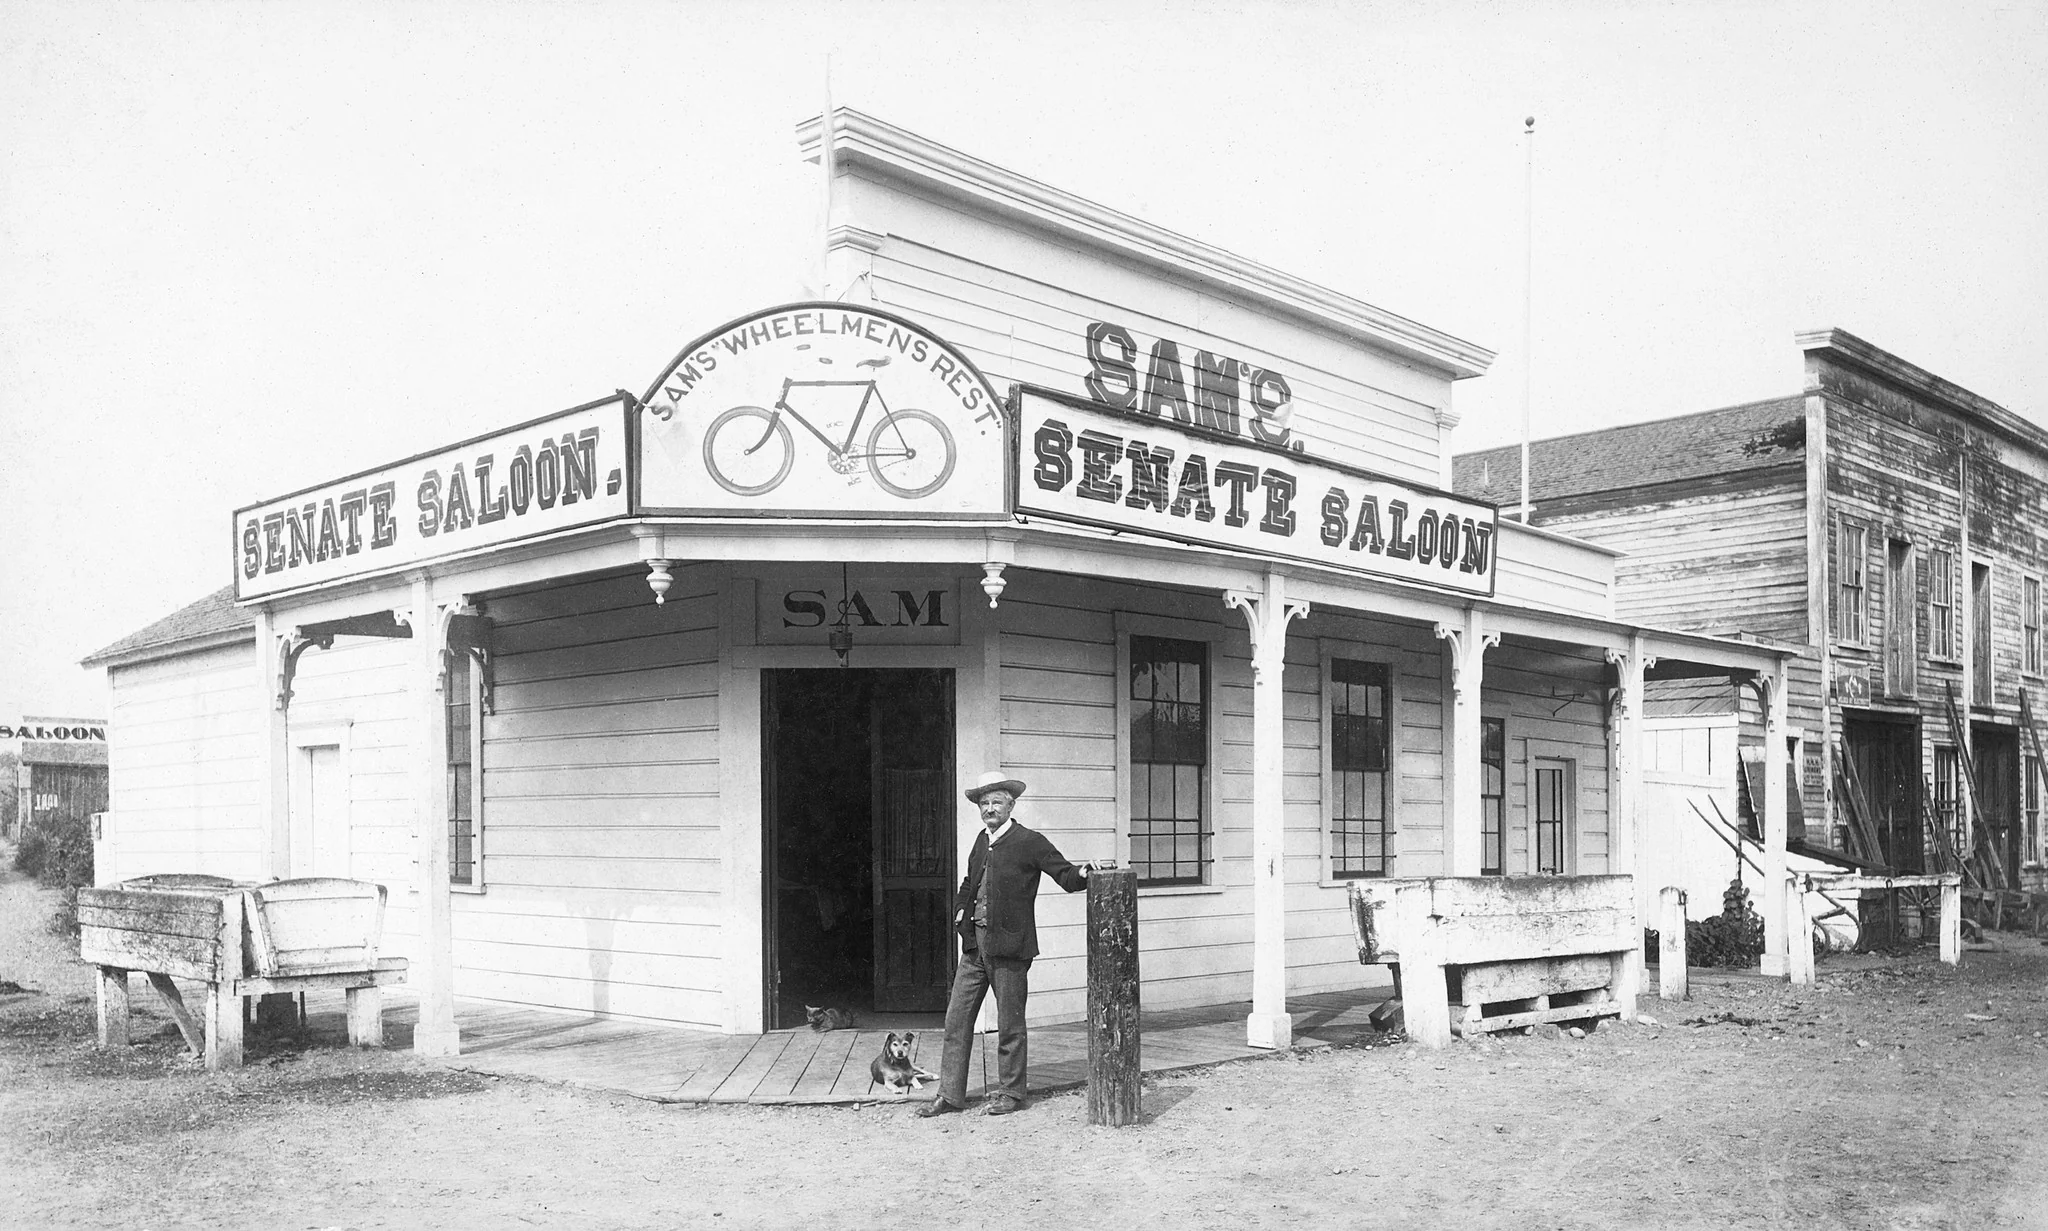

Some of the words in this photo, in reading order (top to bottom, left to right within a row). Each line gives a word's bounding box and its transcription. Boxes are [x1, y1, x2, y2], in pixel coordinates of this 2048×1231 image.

[650, 350, 717, 422] SAM'S
[242, 480, 398, 580] SENATE
[416, 426, 622, 539] SALOON.
[1033, 417, 1298, 538] SENATE
[1319, 485, 1494, 576] SALOON
[782, 589, 950, 629] SAM
